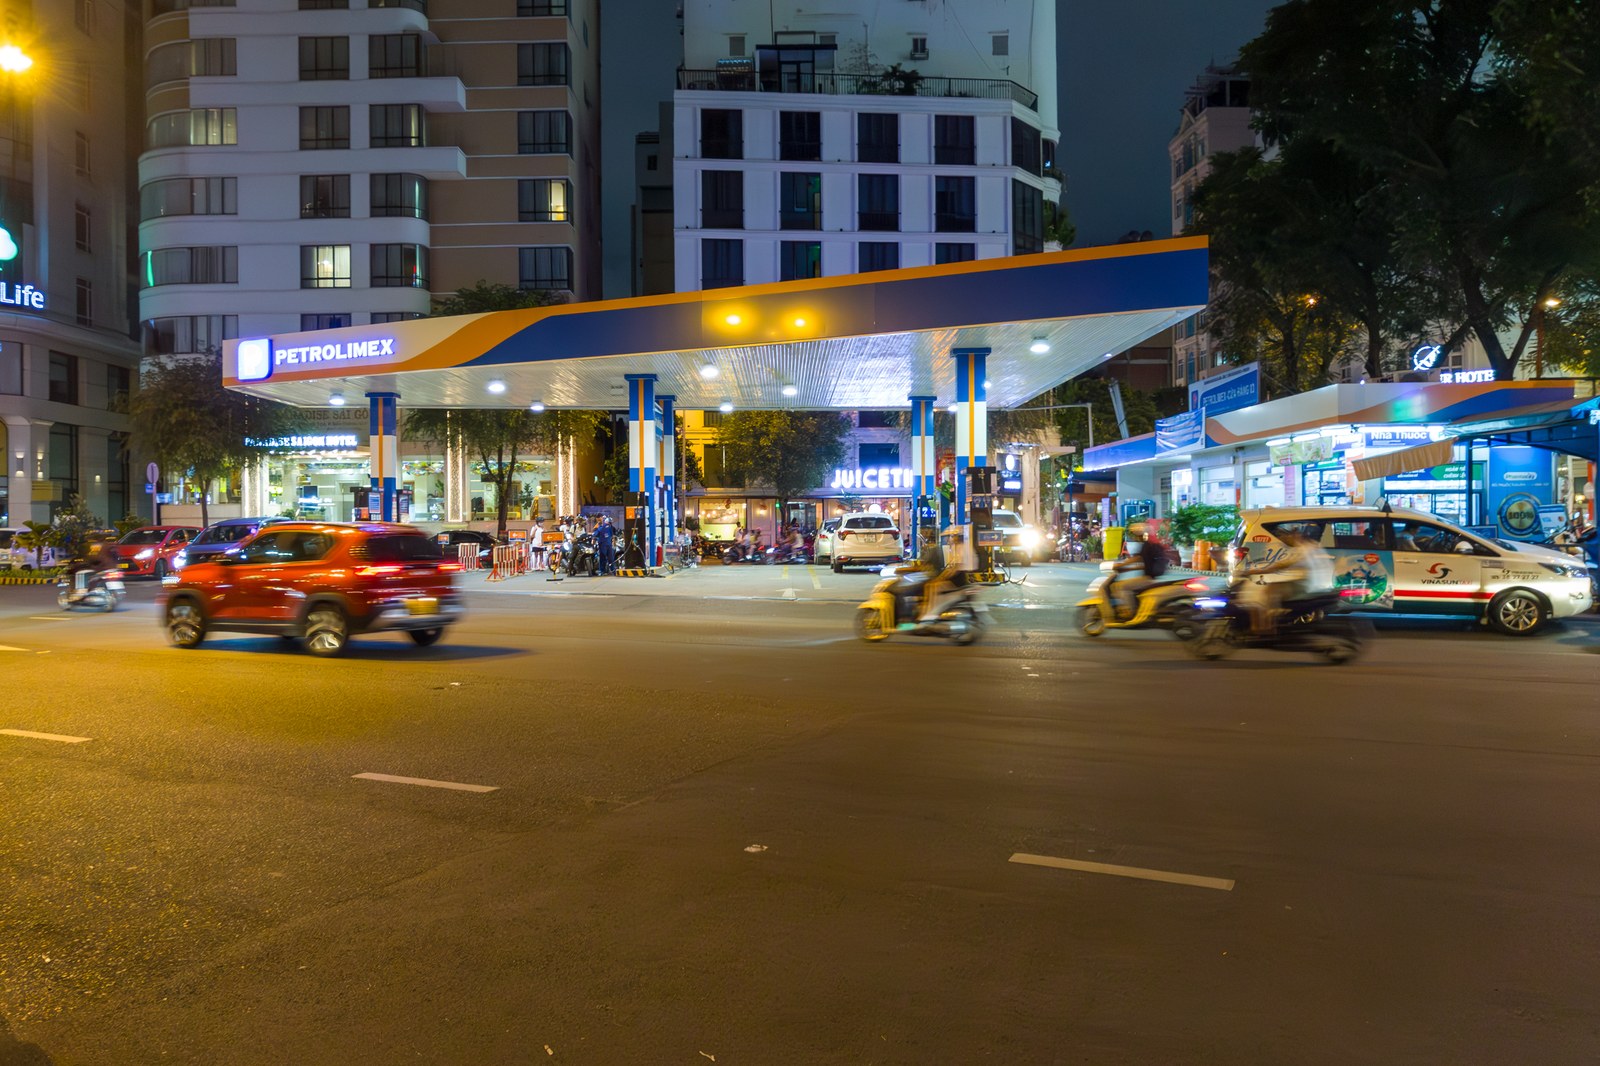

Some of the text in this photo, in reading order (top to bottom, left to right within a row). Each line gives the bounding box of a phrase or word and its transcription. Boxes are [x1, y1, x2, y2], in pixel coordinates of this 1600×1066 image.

[0, 281, 44, 309] Life
[275, 338, 394, 366] PETROLIMEX
[1455, 369, 1495, 384] HOTE
[354, 407, 369, 420] GÒ
[325, 435, 358, 447] HOTEL
